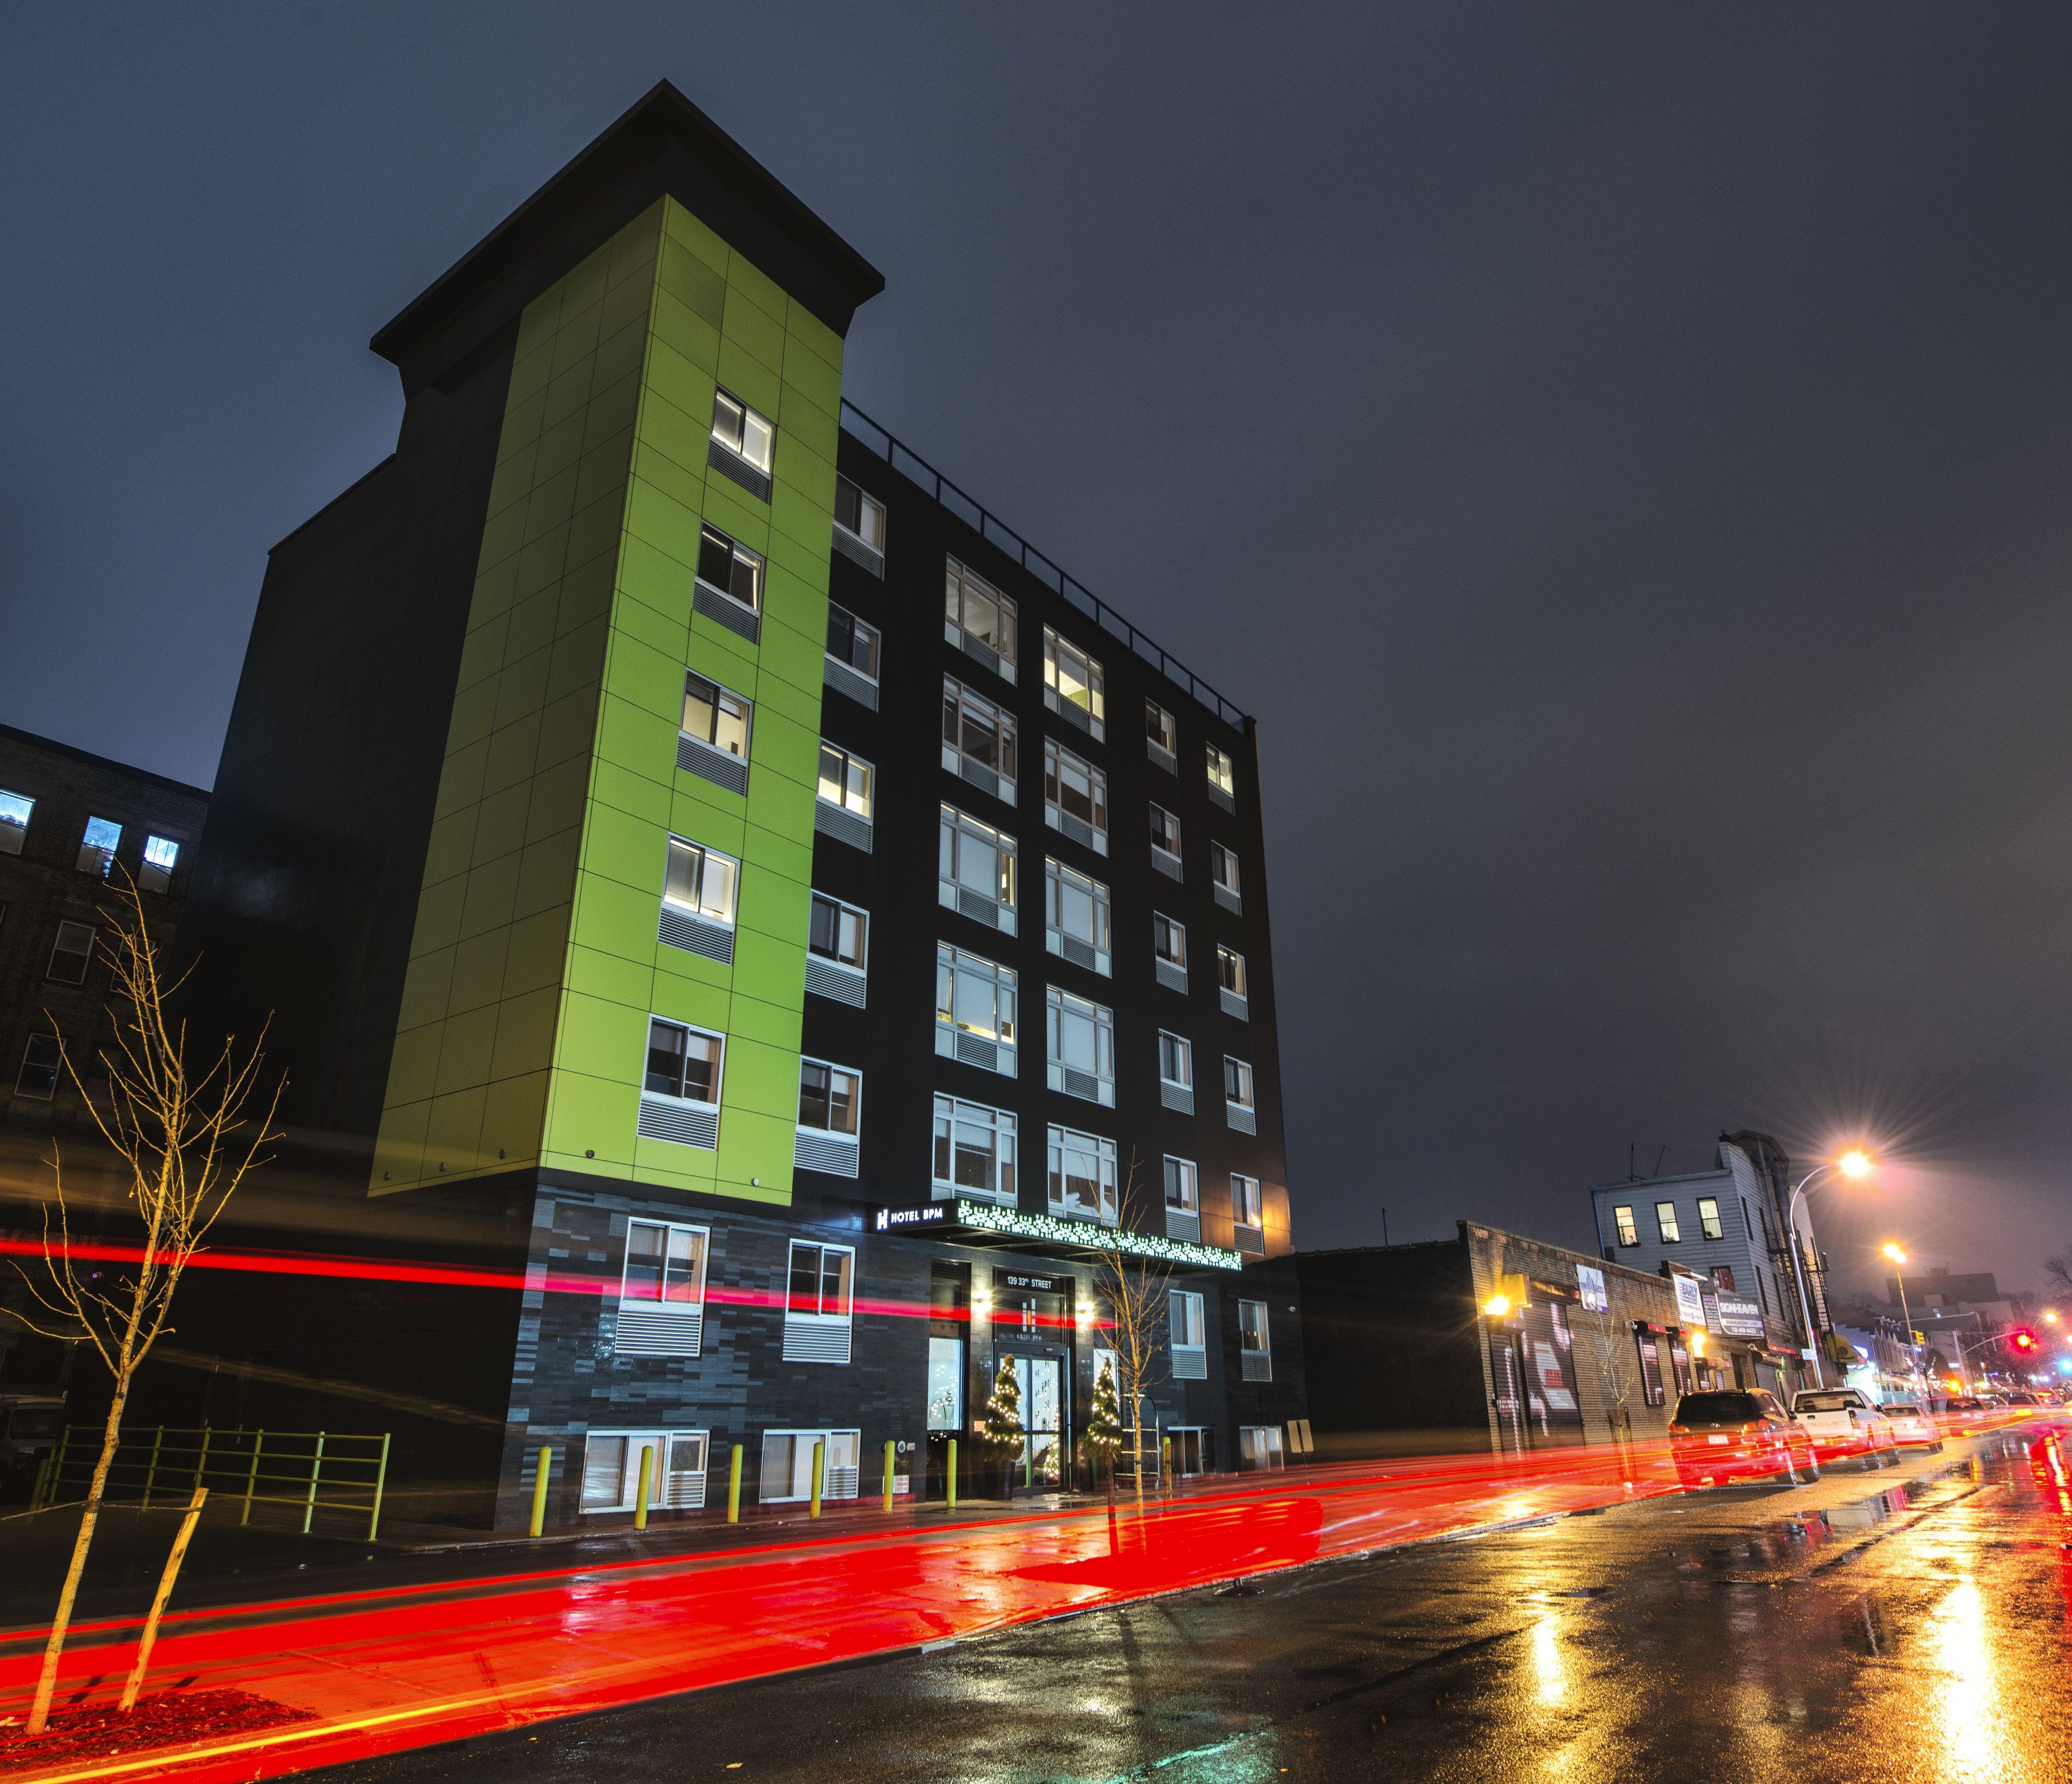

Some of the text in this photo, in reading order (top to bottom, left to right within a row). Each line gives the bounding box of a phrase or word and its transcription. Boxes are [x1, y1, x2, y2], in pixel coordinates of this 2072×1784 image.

[891, 1210, 919, 1223] HOTEL
[923, 1208, 943, 1220] BPM
[1007, 1276, 1017, 1285] 139
[1031, 1278, 1052, 1289] STREET
[1682, 1283, 1698, 1299] EARLY
[1720, 1303, 1759, 1315] SIGNHEAVEN
